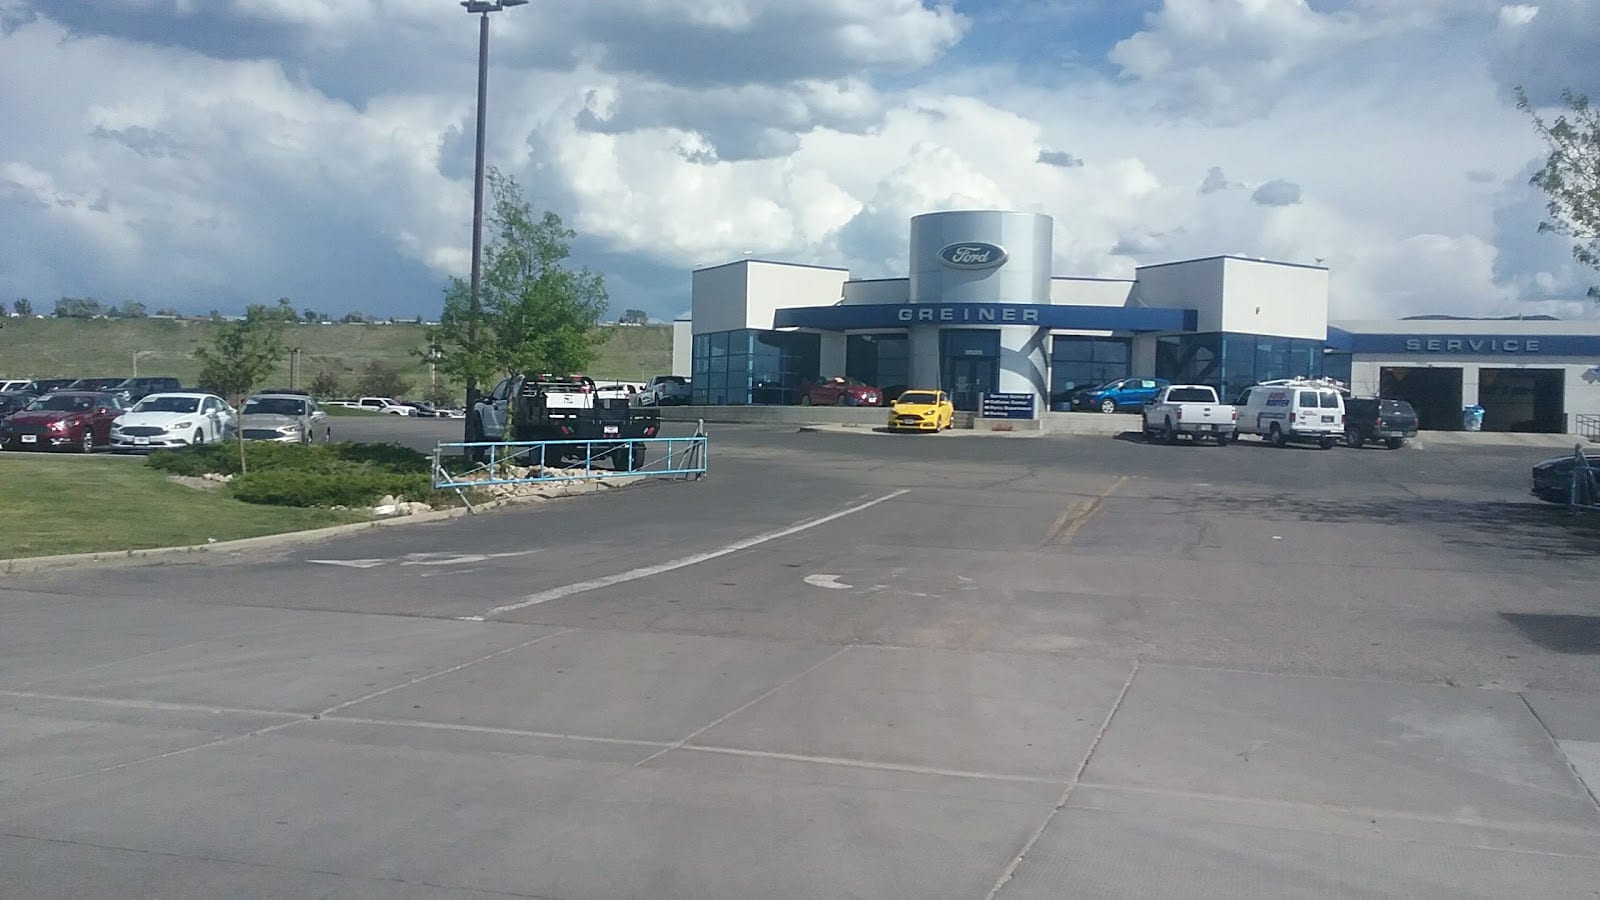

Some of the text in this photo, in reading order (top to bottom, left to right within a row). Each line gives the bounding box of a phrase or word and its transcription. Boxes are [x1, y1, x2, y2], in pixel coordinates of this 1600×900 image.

[952, 246, 990, 263] Ford
[898, 308, 1039, 321] GREINER
[1406, 339, 1540, 351] SERVICE
